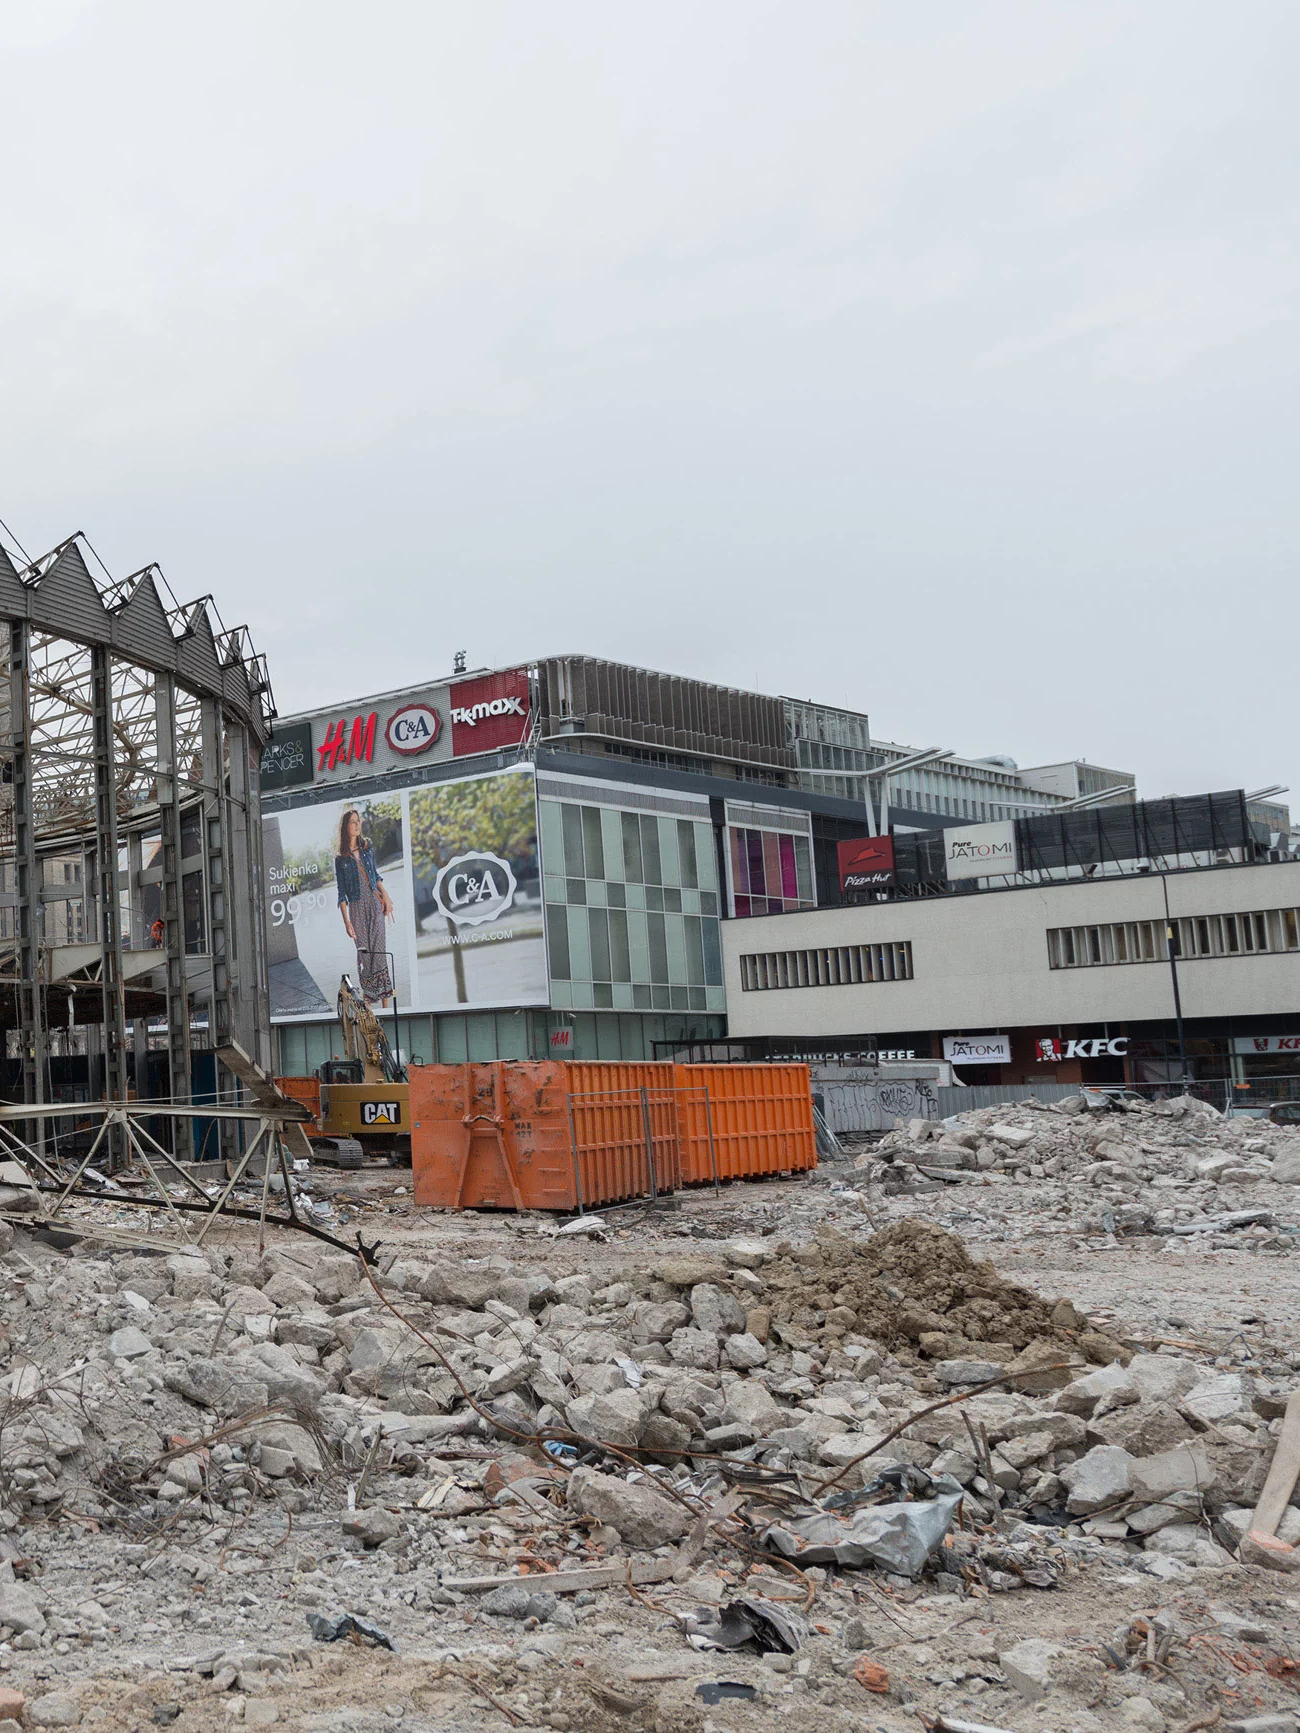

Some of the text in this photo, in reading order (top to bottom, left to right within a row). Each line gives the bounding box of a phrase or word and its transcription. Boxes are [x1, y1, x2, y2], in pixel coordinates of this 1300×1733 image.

[395, 715, 432, 742] C&A
[262, 740, 303, 759] ARKS&
[317, 711, 377, 771] H&M
[260, 753, 305, 775] PENCER
[949, 842, 1012, 860] JATOMI
[269, 860, 318, 881] Sukienka
[844, 871, 893, 888] Pizza Hut
[270, 882, 296, 895] maxi
[448, 870, 502, 905] C&A
[950, 1044, 1004, 1057] JATOMI
[1064, 1037, 1129, 1059] KFC
[364, 1103, 398, 1124] CAT
